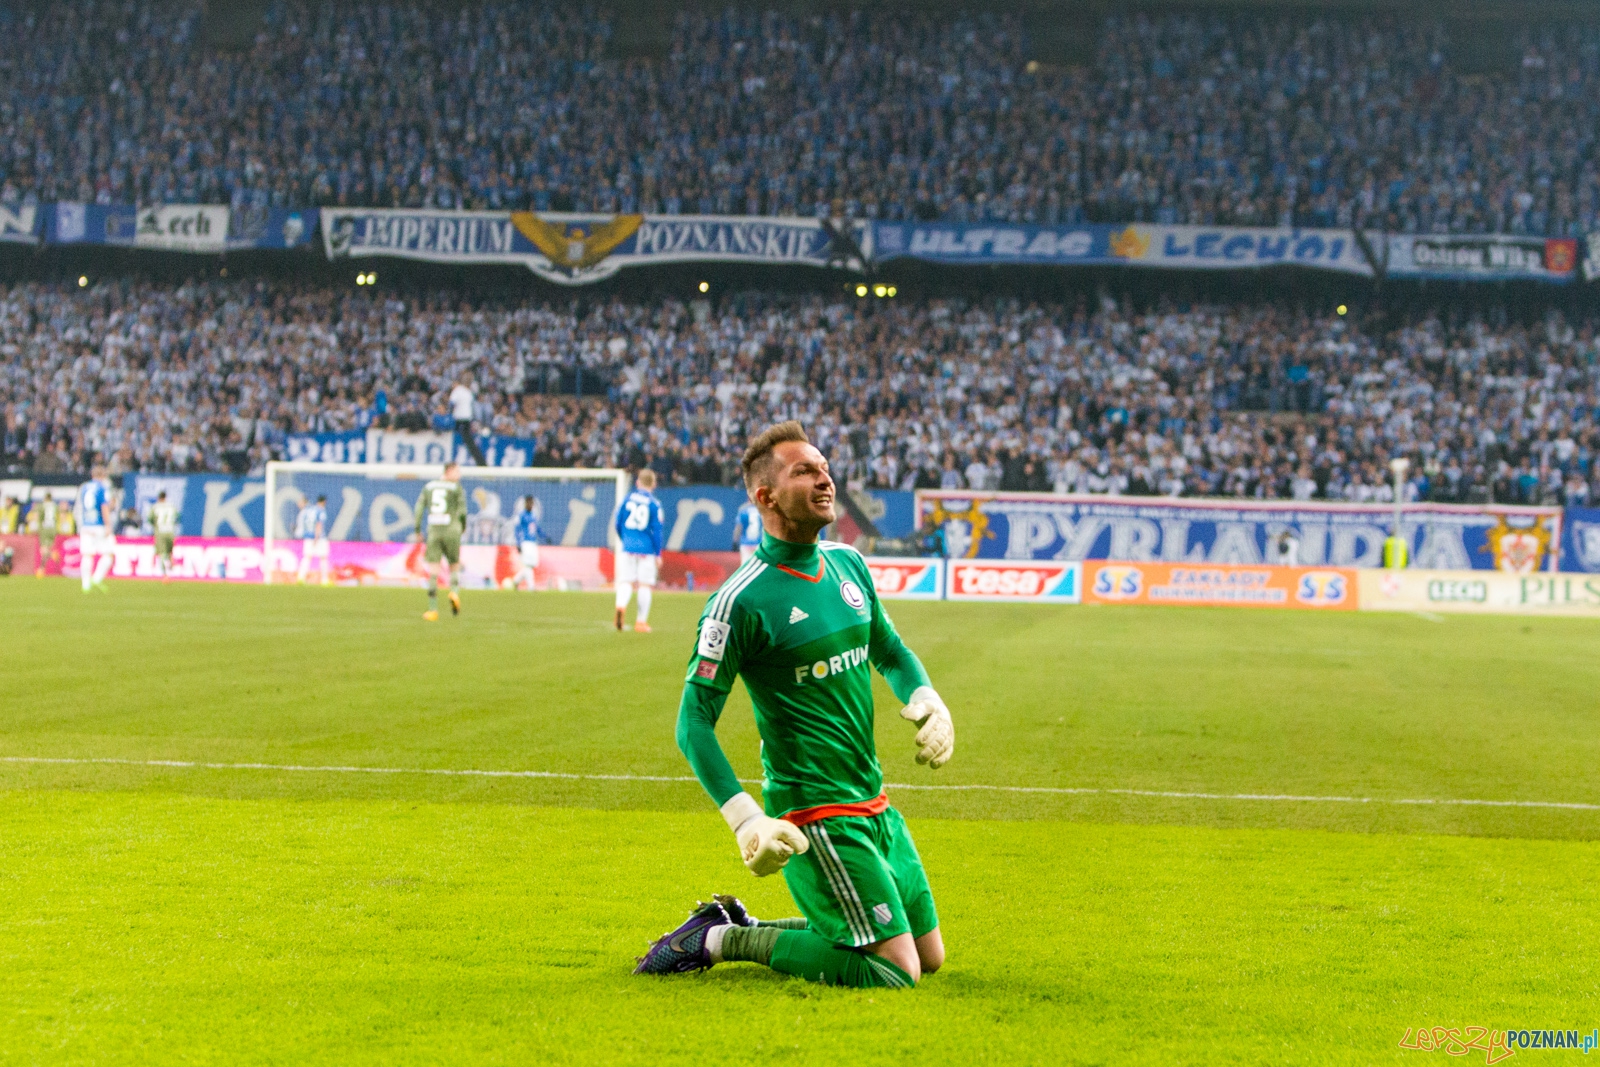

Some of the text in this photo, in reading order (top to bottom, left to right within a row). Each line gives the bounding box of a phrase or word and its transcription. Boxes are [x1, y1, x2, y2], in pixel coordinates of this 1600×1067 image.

[362, 216, 515, 253] IMPERIUM
[431, 488, 447, 514] 5
[624, 501, 650, 531] 29
[957, 567, 1044, 595] tesa
[1095, 568, 1141, 598] STS
[1299, 573, 1347, 602] STS
[1430, 579, 1486, 601] LECH
